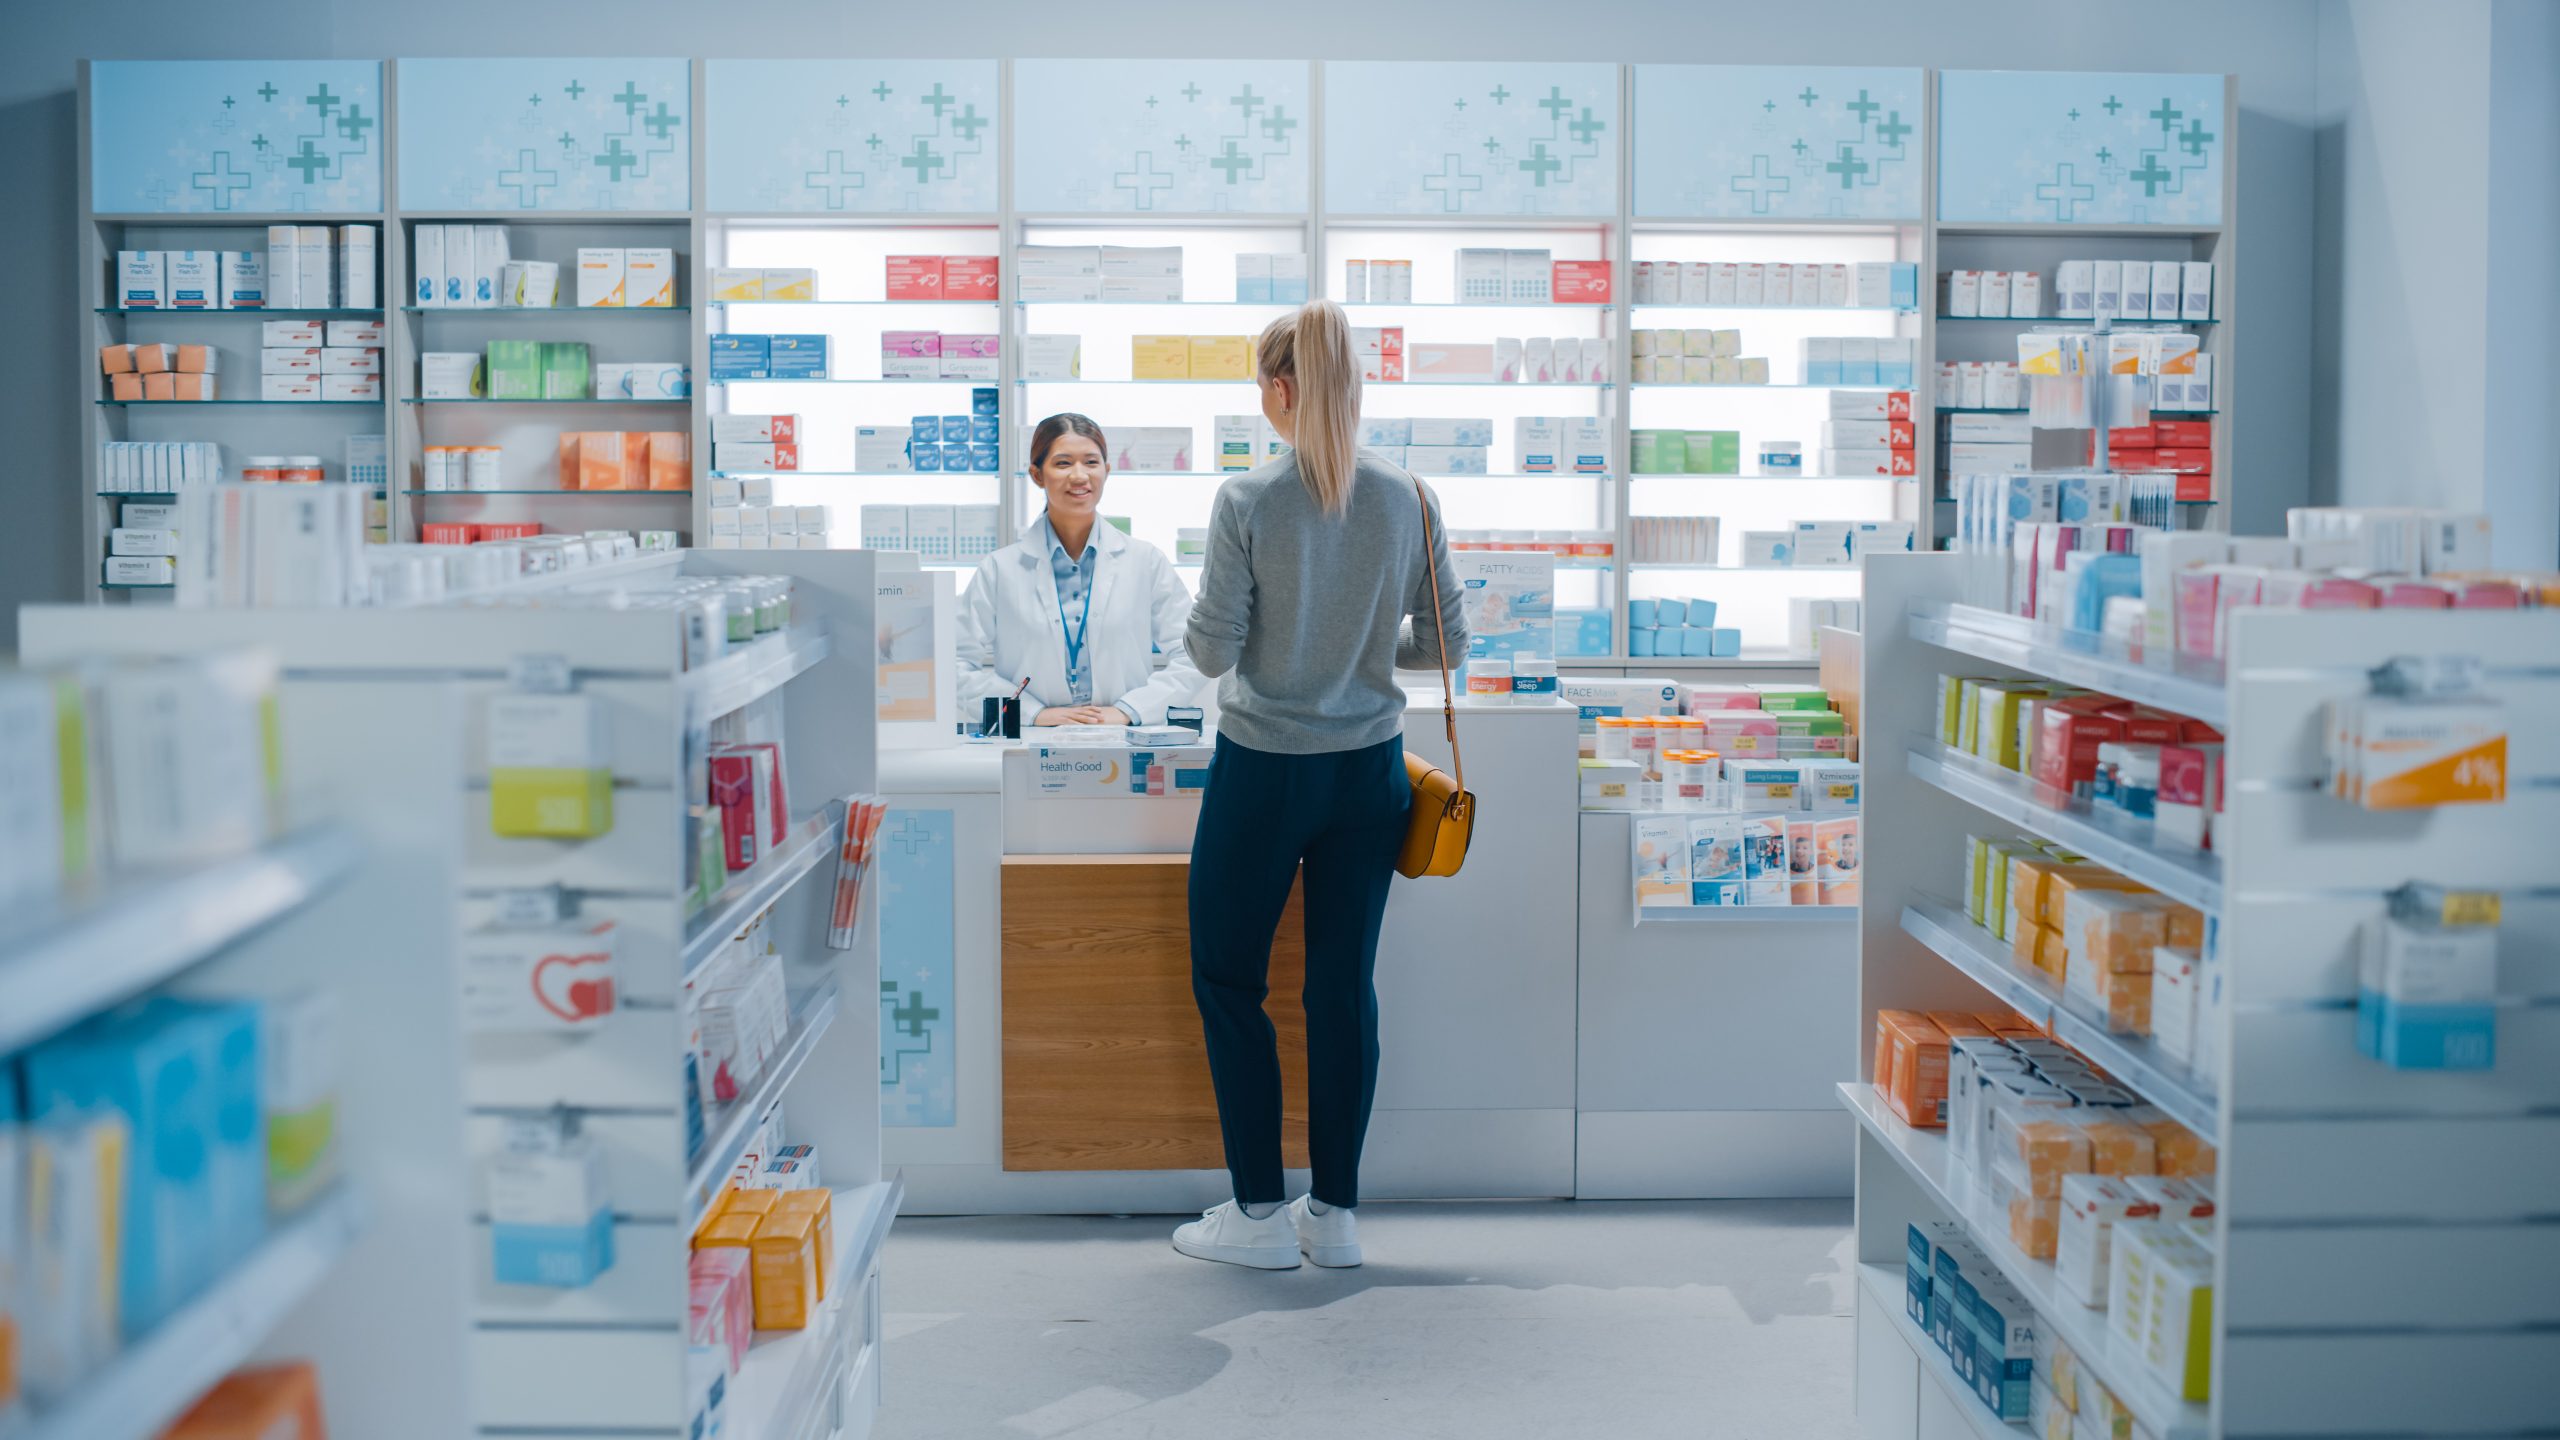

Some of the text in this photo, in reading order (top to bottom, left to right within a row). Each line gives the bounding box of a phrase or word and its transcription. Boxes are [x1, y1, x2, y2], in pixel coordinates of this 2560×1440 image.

[774, 421, 792, 436] 7%
[777, 450, 796, 466] 7%
[1480, 564, 1514, 574] FATTY
[1471, 682, 1497, 692] Energy
[1516, 680, 1538, 692] Sleep
[1568, 688, 1592, 697] FACE
[1040, 761, 1102, 772] Health Good
[1642, 830, 1669, 838] Vitamin
[2014, 1328, 2034, 1342] FA
